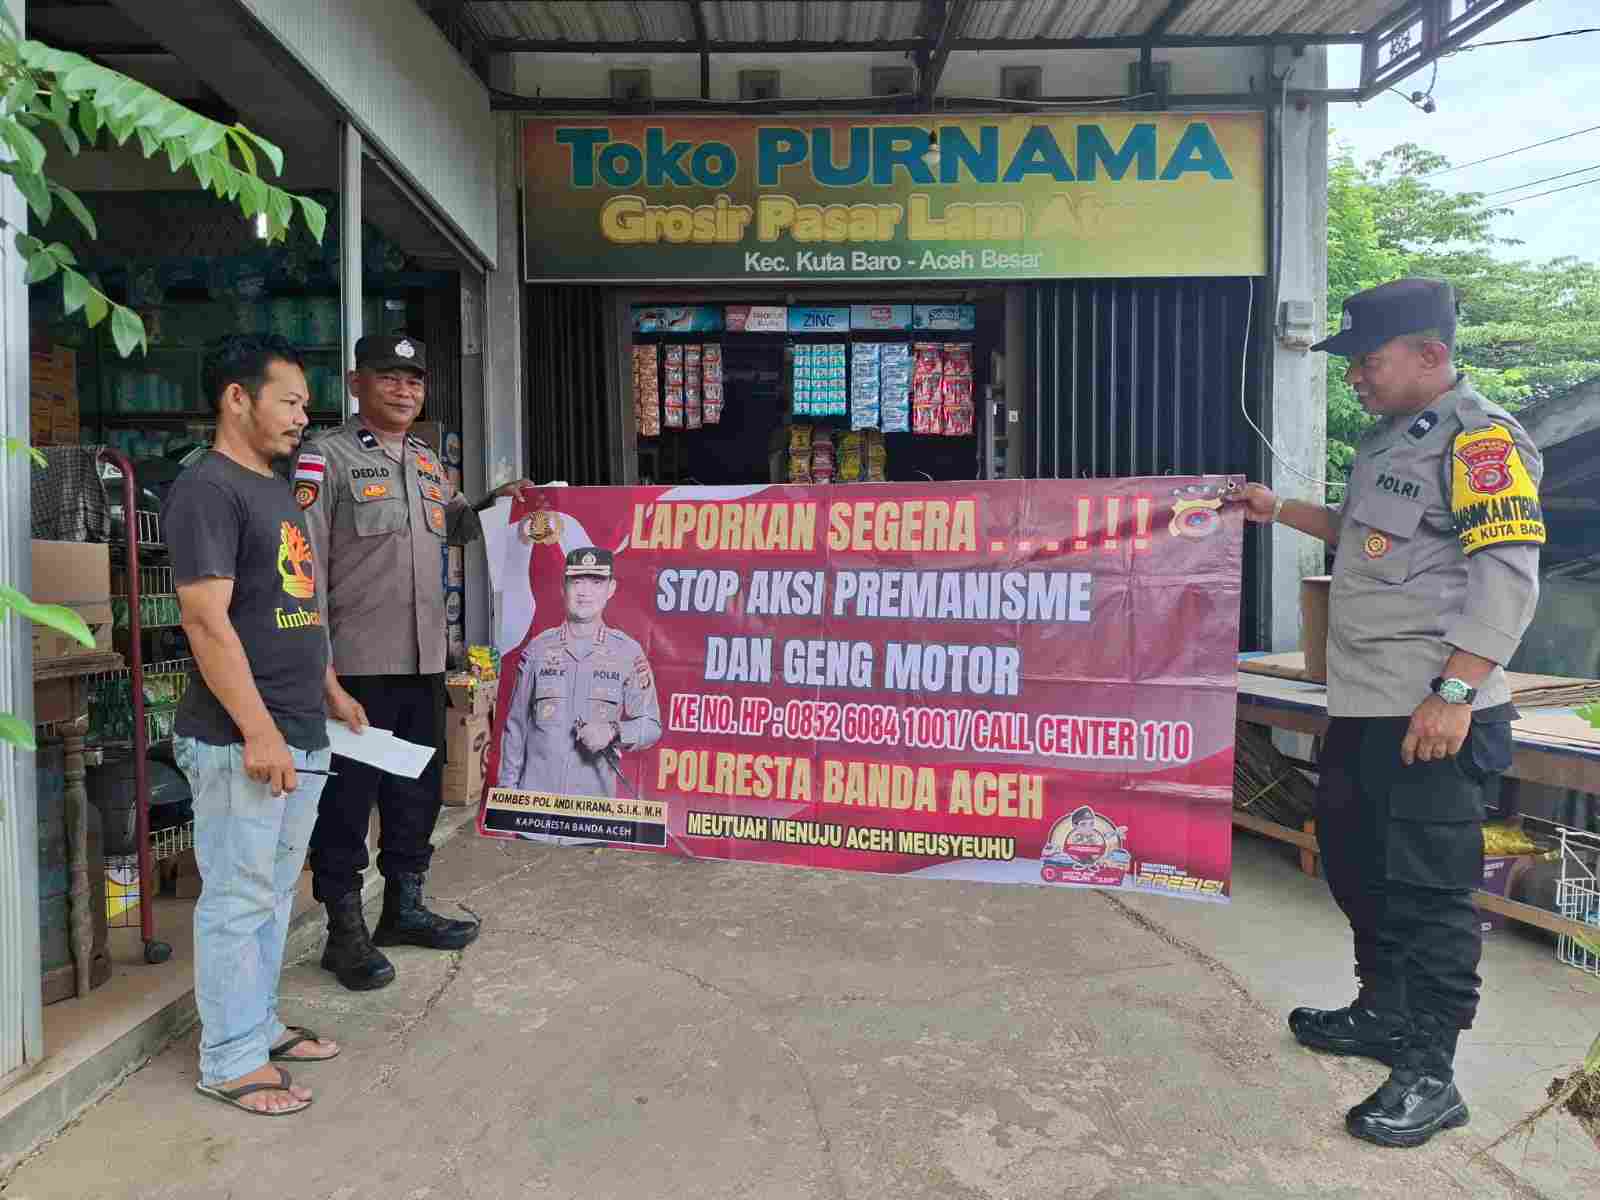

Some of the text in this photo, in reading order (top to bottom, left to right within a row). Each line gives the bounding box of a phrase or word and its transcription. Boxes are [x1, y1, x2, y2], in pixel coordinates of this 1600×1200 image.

[556, 122, 1233, 187] Toko PURNAMA
[602, 194, 751, 243] Grosir
[757, 194, 902, 241] Pasar
[908, 193, 1023, 240] Lam
[745, 252, 789, 272] Kec.
[796, 250, 845, 271] Kuta
[852, 250, 900, 271] Baro
[919, 250, 973, 270] Aceh
[981, 250, 1042, 270] Besar
[803, 312, 835, 327] ZINC
[1376, 474, 1420, 498] POLRI
[827, 500, 977, 551] SEGERA
[1480, 524, 1515, 540] KUTA
[657, 569, 1092, 621] STOP AKSI PREMANISME
[704, 636, 1020, 696] DAN GENG MOTOR
[670, 694, 700, 731] KE
[701, 695, 737, 734] NO.
[785, 700, 841, 741] 0852
[842, 704, 900, 746] 6084
[1036, 714, 1137, 760] CENTER
[1142, 720, 1193, 763] 110
[491, 792, 530, 806] KOMBES
[533, 795, 551, 807] POL
[553, 797, 574, 809] ANDI
[656, 748, 1043, 820] POLRESTA BANDA ACEH
[515, 817, 632, 837] KAPOLRESTA BANDA ACEH
[688, 812, 1015, 860] MEUTUAH MENUJU ACEH MEUSYEUHU
